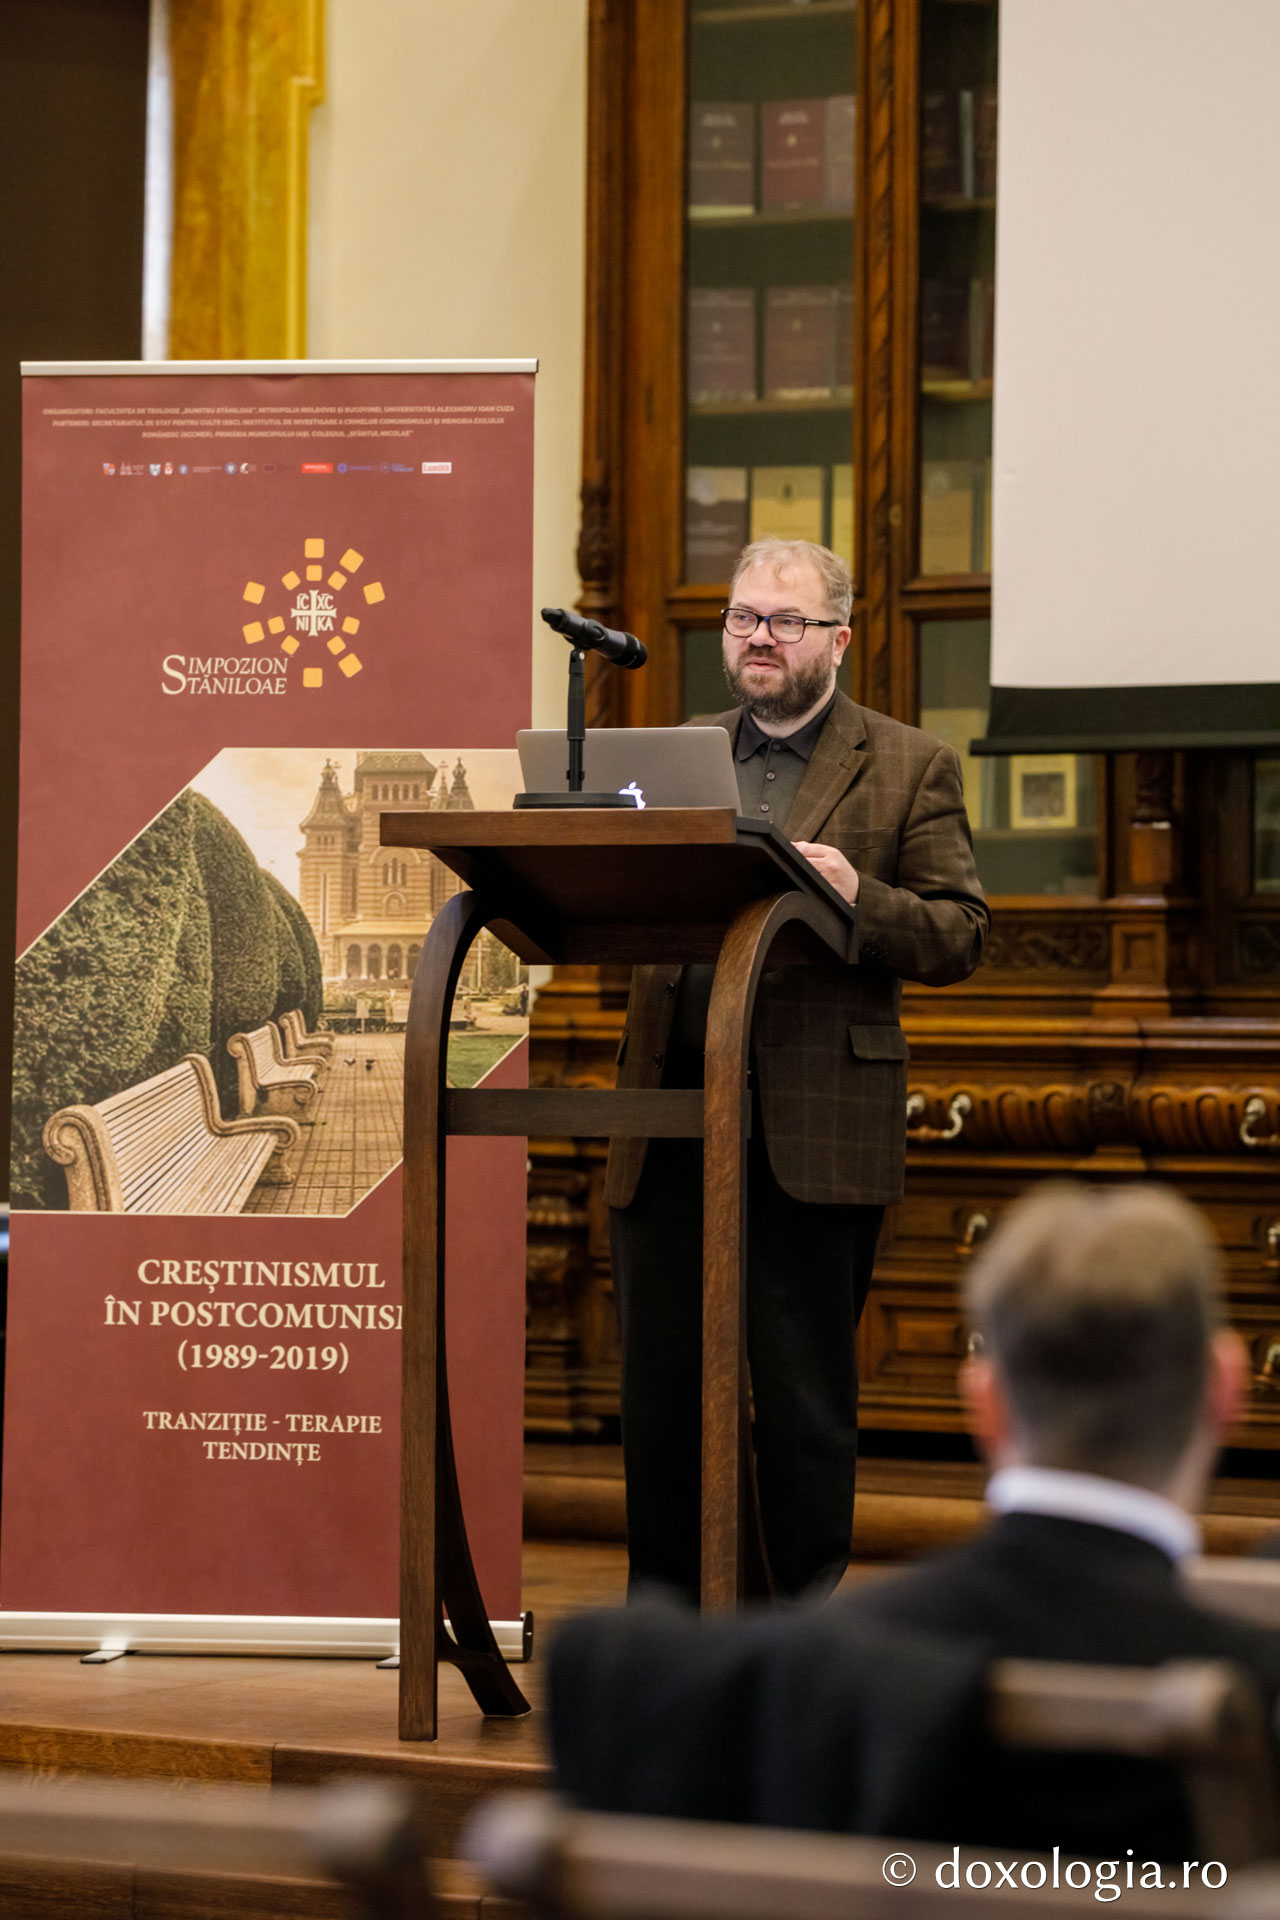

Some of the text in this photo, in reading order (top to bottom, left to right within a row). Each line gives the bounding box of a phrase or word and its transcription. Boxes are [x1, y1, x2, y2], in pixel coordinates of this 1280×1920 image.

[137, 407, 146, 415] DE
[145, 419, 154, 427] DE
[137, 1259, 386, 1294] CREȘTINISMUL
[104, 1294, 142, 1326] ÎN
[178, 1339, 349, 1375] (1989-2019)
[143, 1411, 268, 1436] TRANZIȚIE
[285, 1414, 383, 1434] TERAPIE
[203, 1441, 322, 1467] TENDINȚE
